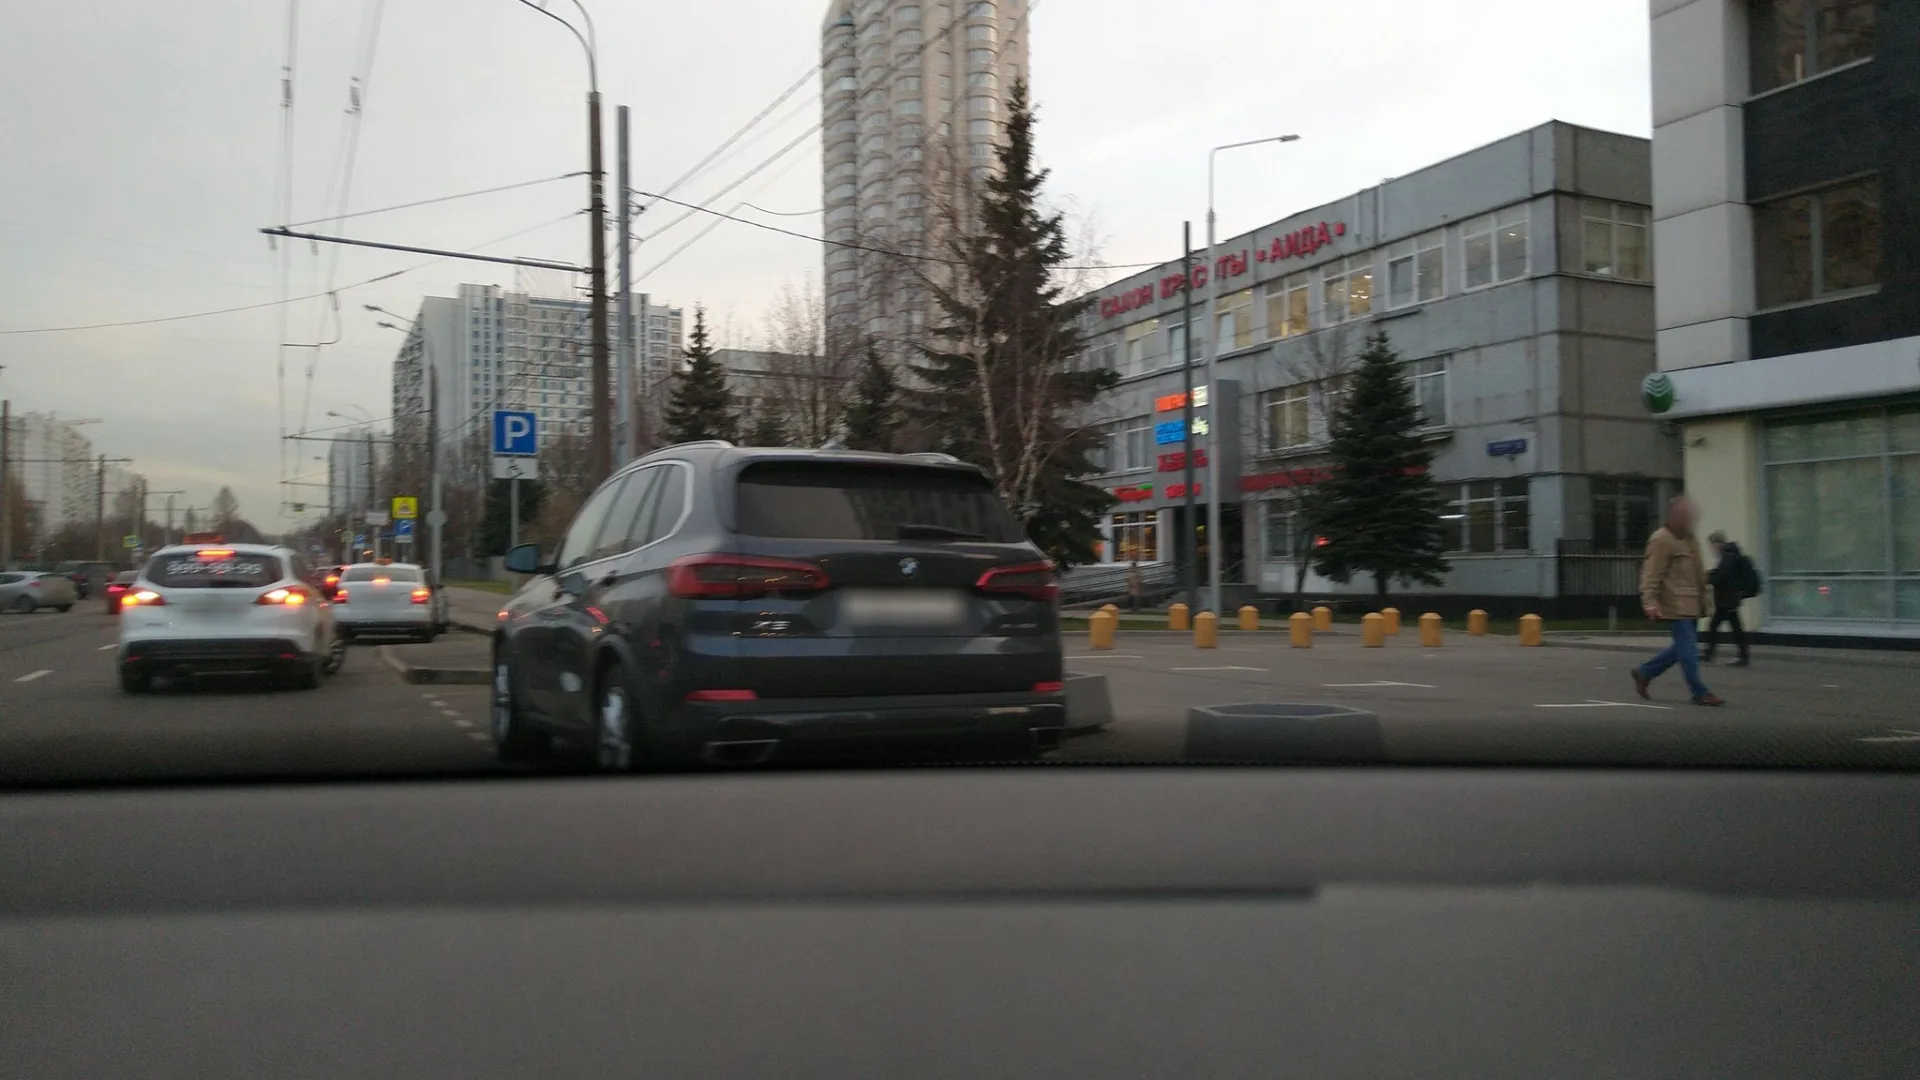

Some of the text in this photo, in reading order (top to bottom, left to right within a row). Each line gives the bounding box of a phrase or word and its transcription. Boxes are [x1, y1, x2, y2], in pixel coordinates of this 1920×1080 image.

[1101, 283, 1153, 319] САЛОН
[1160, 249, 1249, 299] КРСТЫ
[503, 416, 530, 449] P
